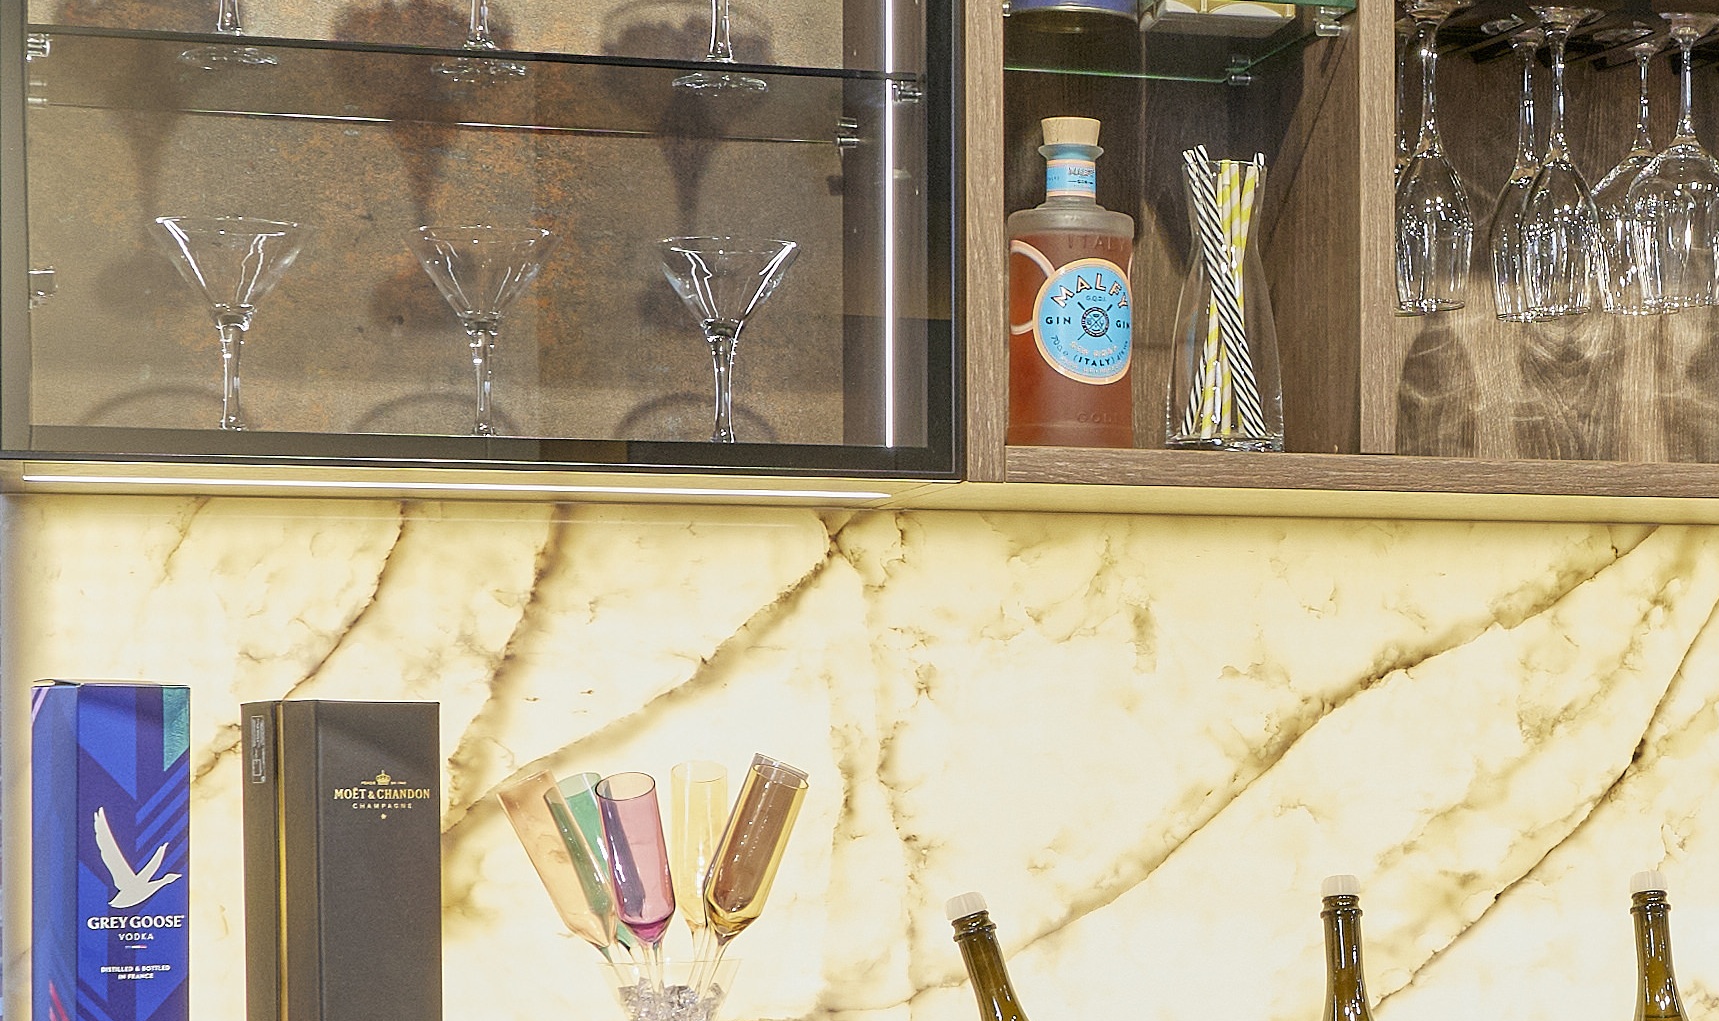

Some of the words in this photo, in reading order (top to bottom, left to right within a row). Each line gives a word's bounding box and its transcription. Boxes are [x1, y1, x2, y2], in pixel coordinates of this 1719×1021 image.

[1051, 273, 1129, 308] MALFY
[1045, 316, 1072, 325] GIN
[1073, 354, 1116, 367] (ITALY)
[367, 790, 376, 800] &
[376, 788, 430, 800] CHANDON
[87, 916, 128, 930] GREY
[129, 915, 182, 929] GOOSE
